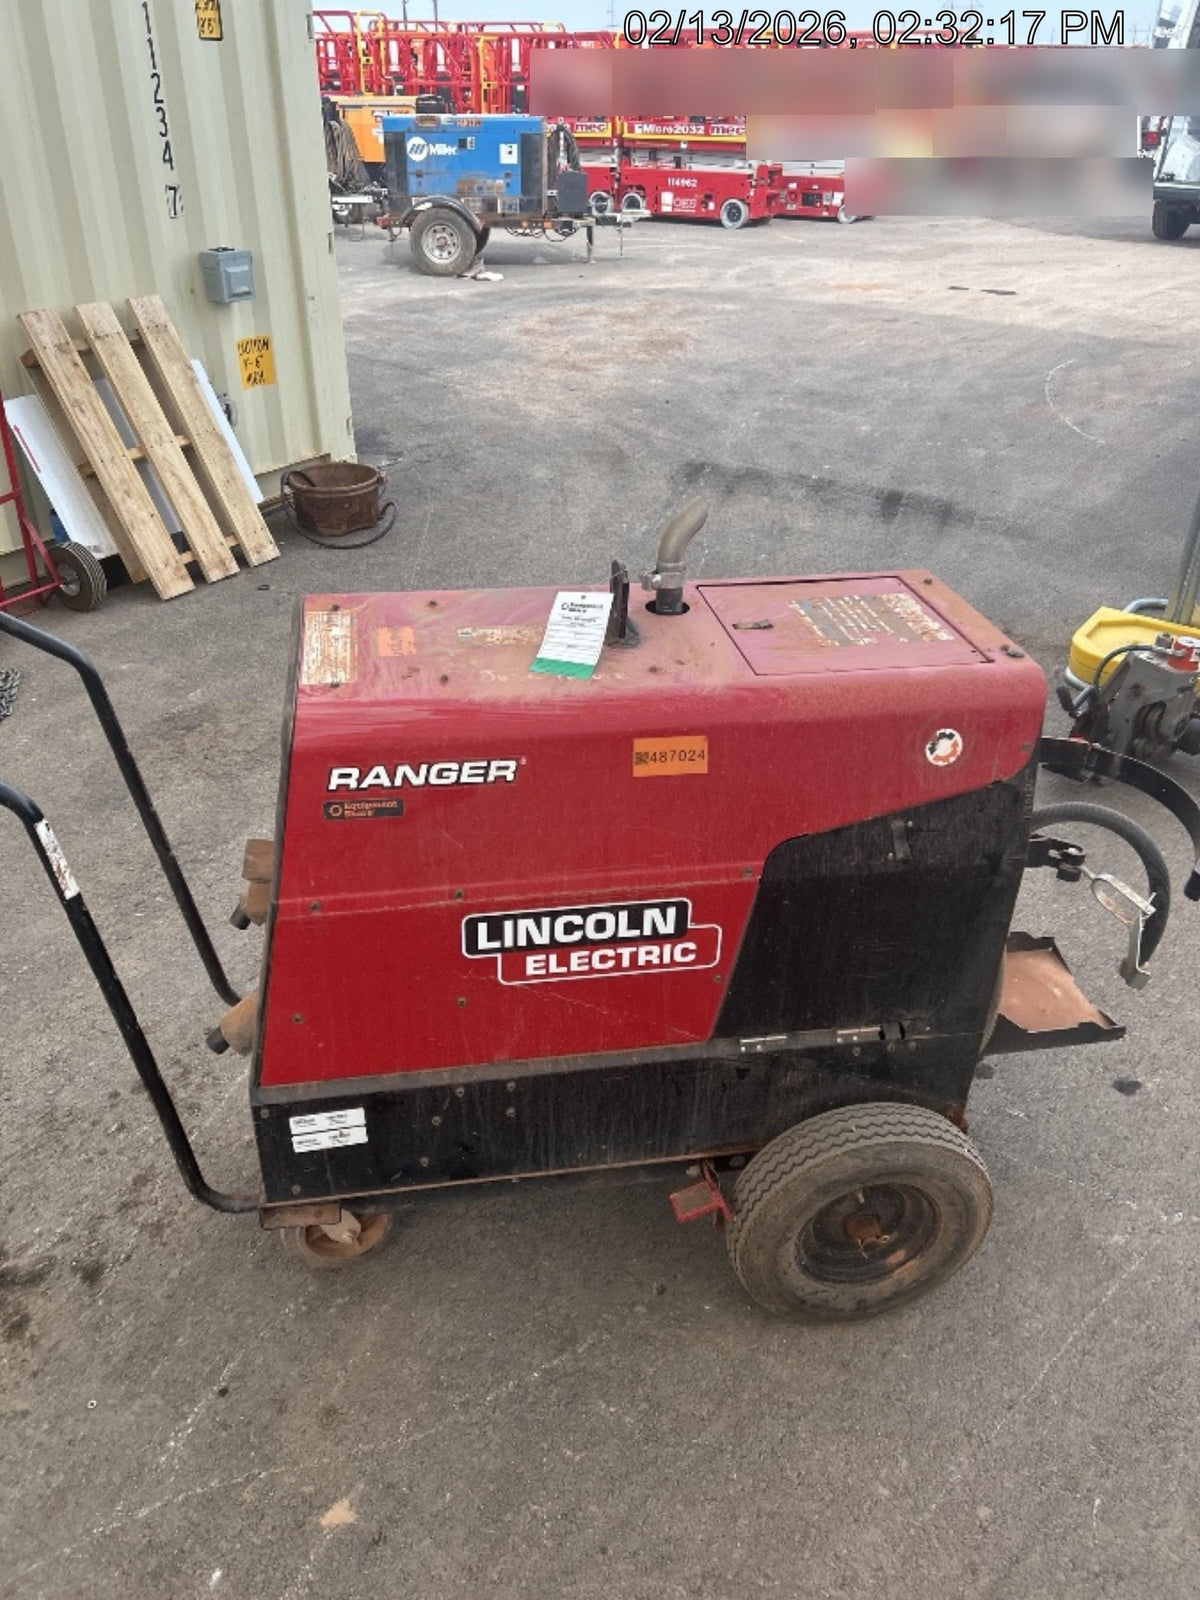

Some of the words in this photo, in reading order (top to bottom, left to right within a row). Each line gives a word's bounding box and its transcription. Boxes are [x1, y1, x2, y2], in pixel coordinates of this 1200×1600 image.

[649, 749, 706, 764] 487024
[327, 759, 518, 791] RANGER
[477, 905, 677, 951] LINCOLN
[525, 941, 698, 976] ELECTRIC
